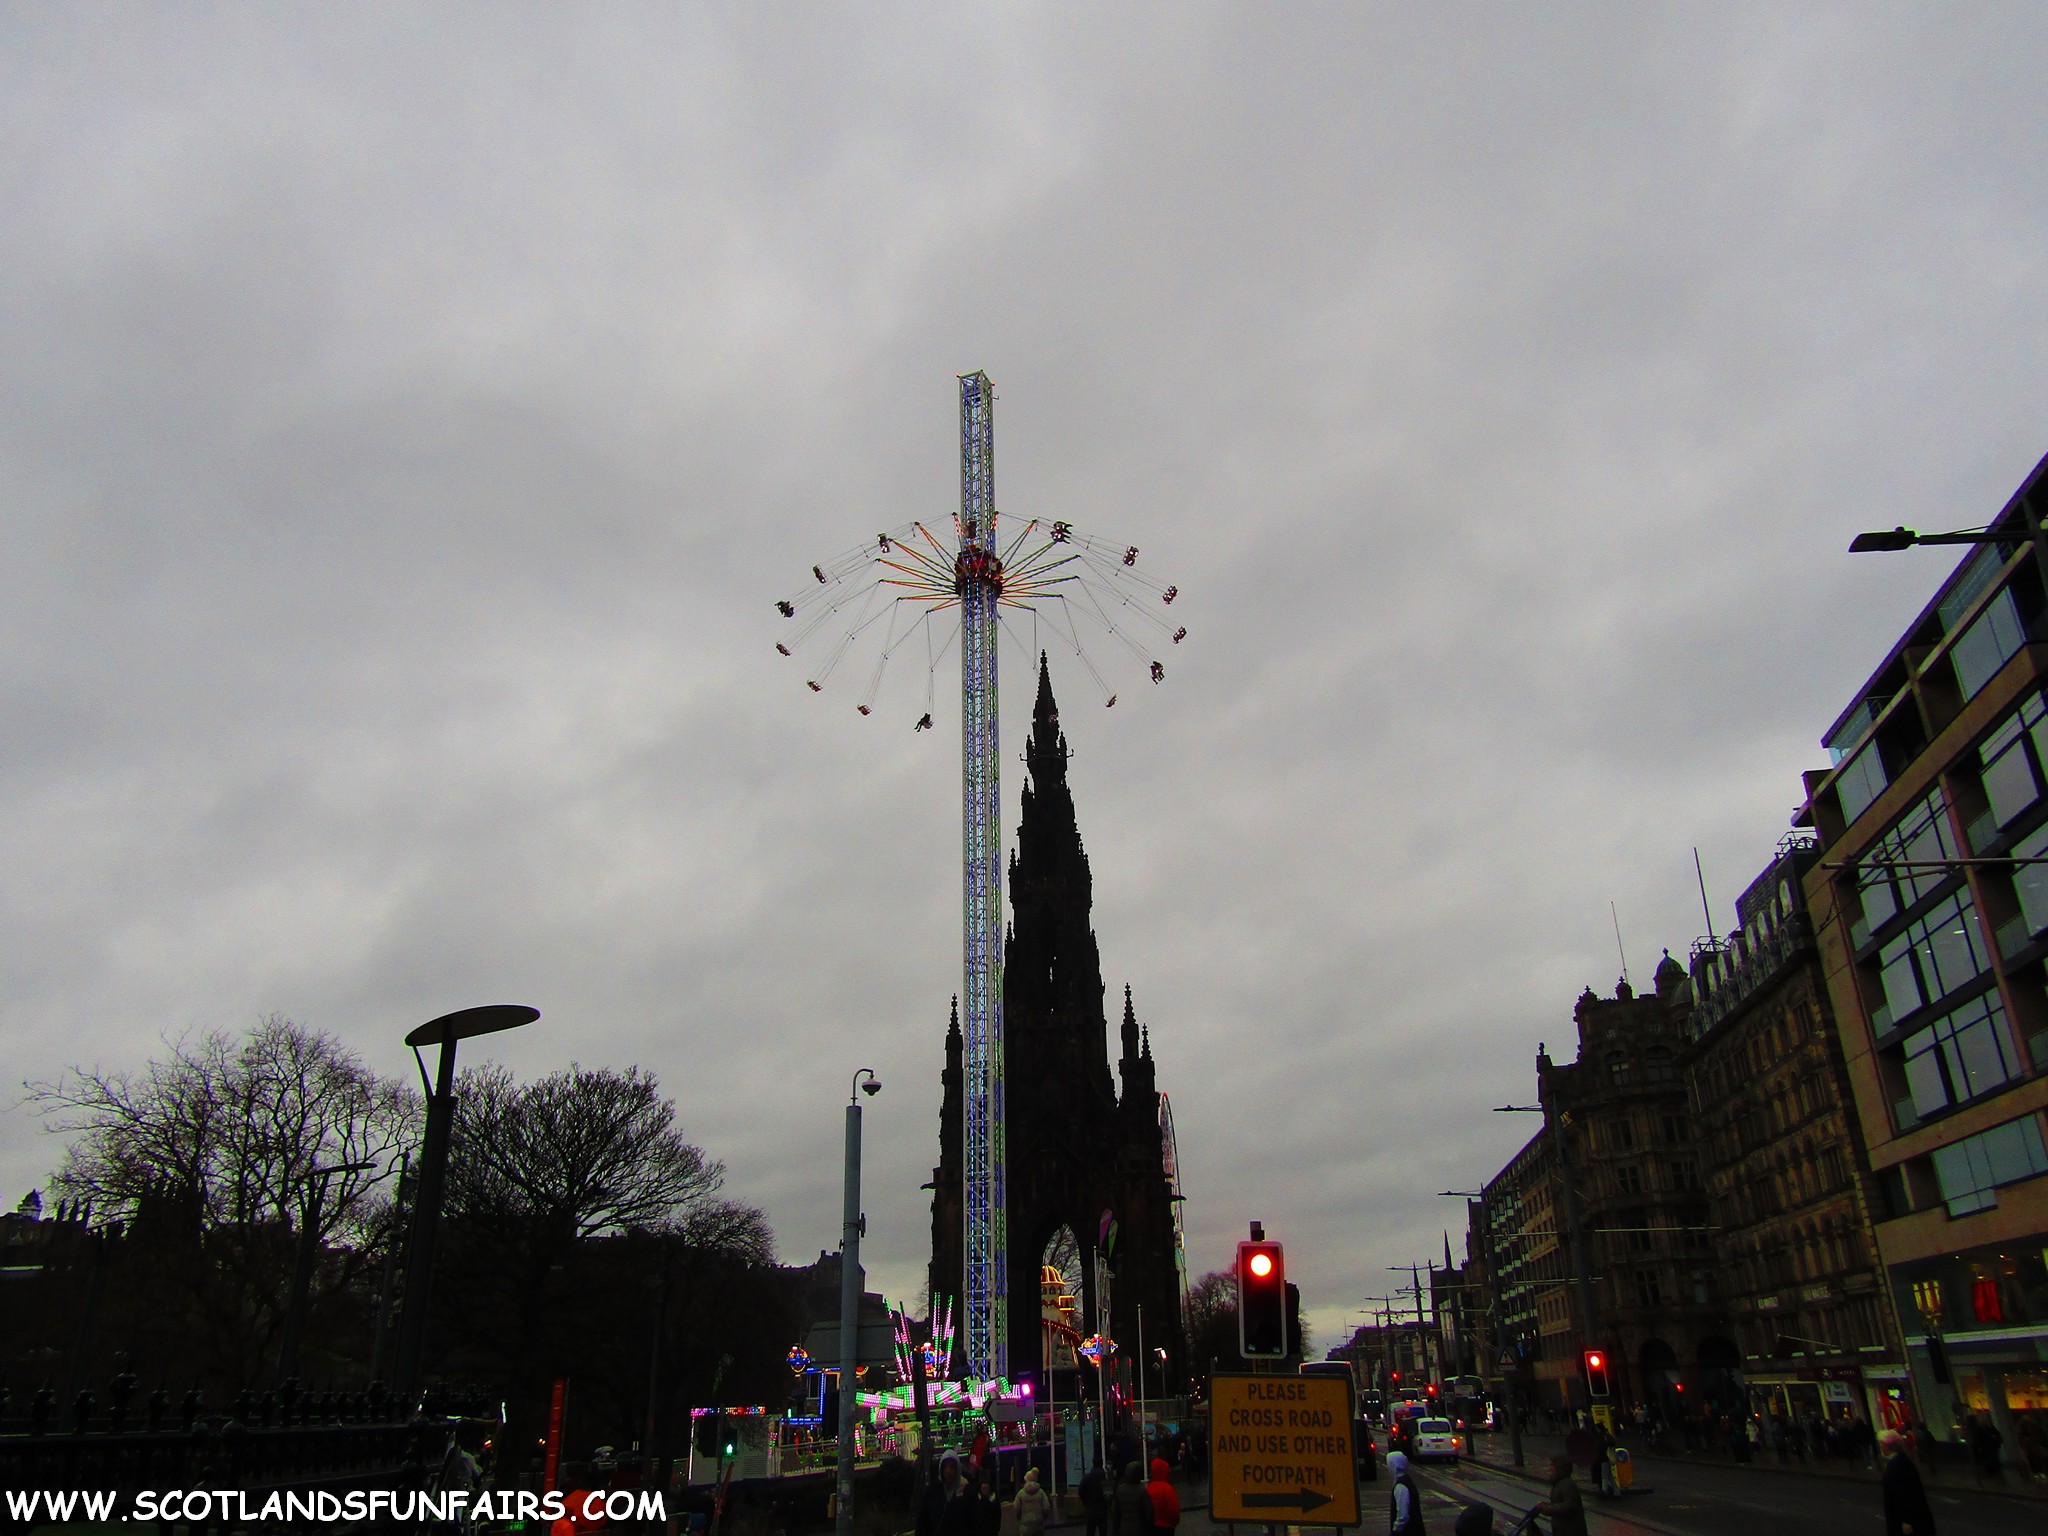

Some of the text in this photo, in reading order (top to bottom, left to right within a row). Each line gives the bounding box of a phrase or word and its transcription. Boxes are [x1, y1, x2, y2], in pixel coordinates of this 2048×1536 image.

[1248, 1383, 1307, 1401] PLEASE
[1229, 1409, 1332, 1428] CROSS ROAD
[1217, 1435, 1347, 1455] AND USE OTHER
[1242, 1465, 1326, 1485] FOOTPATH
